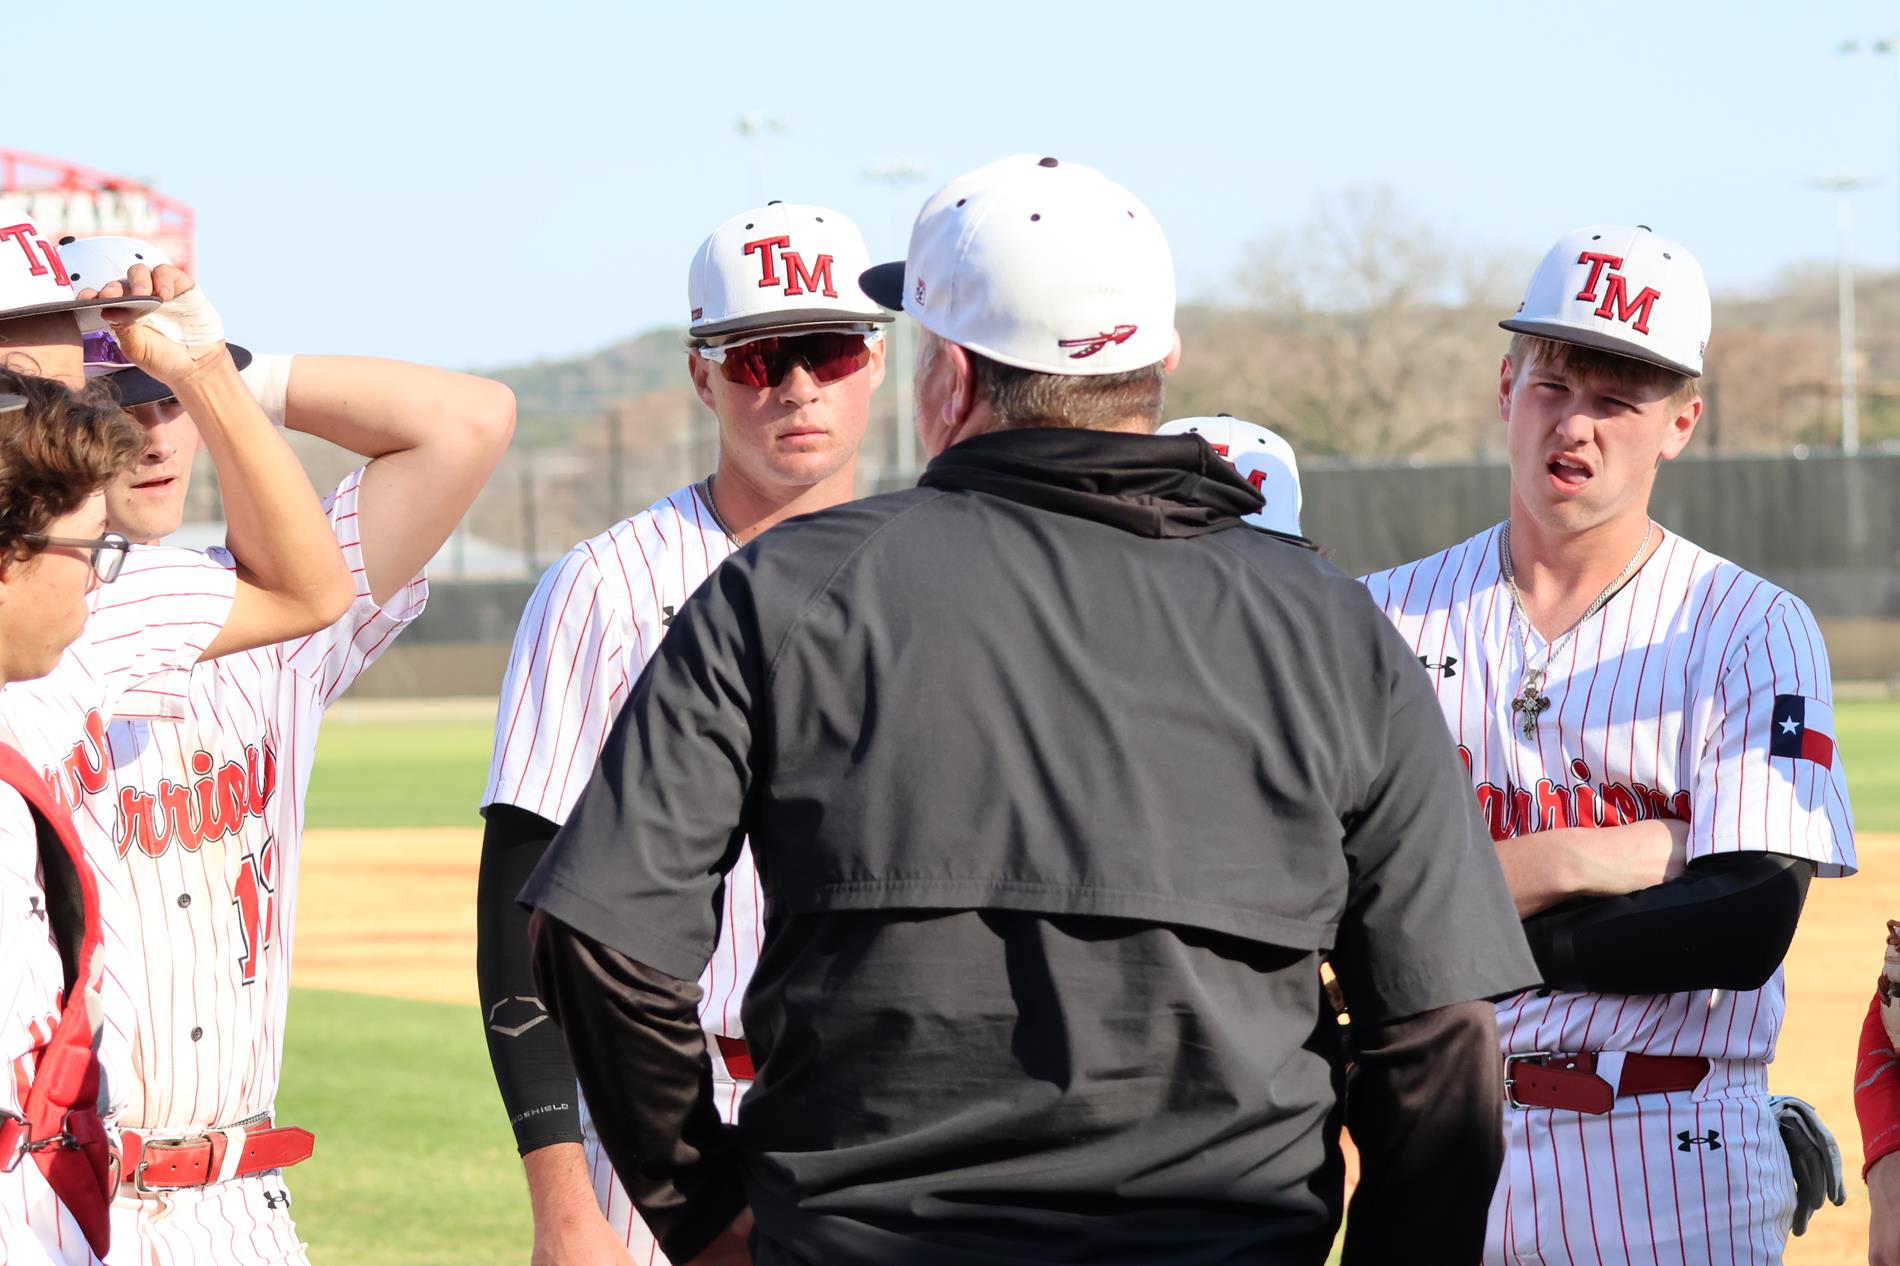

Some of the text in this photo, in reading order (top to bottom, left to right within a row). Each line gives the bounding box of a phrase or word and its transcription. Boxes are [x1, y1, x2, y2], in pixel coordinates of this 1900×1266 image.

[744, 235, 838, 298] TM
[1576, 251, 1661, 335] TM
[232, 835, 275, 986] 1
